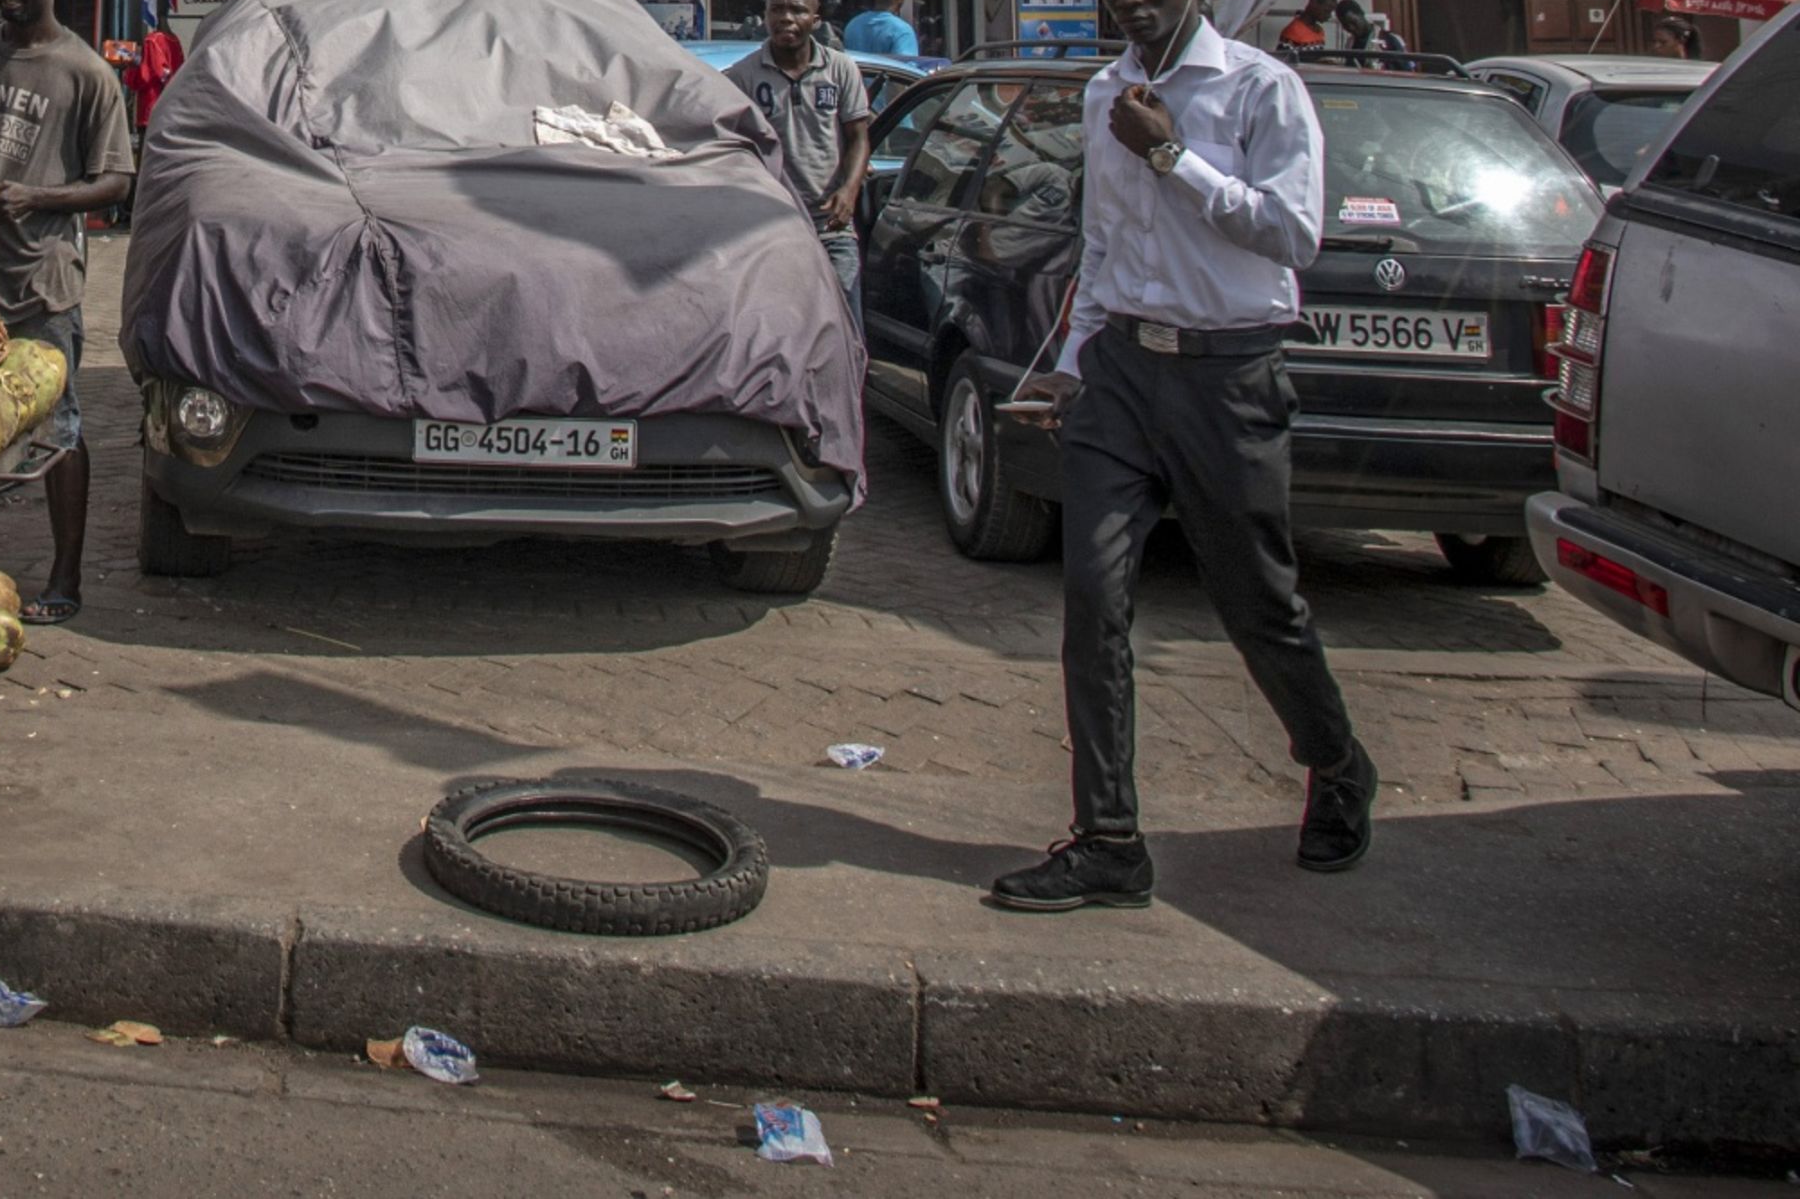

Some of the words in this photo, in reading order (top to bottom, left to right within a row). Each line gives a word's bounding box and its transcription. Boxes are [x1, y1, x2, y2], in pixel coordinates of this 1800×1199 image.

[1350, 314, 1434, 351] 5566
[1441, 317, 1465, 352] V
[424, 423, 461, 452] GG
[477, 424, 601, 457] 4504-16
[609, 447, 630, 460] GH
